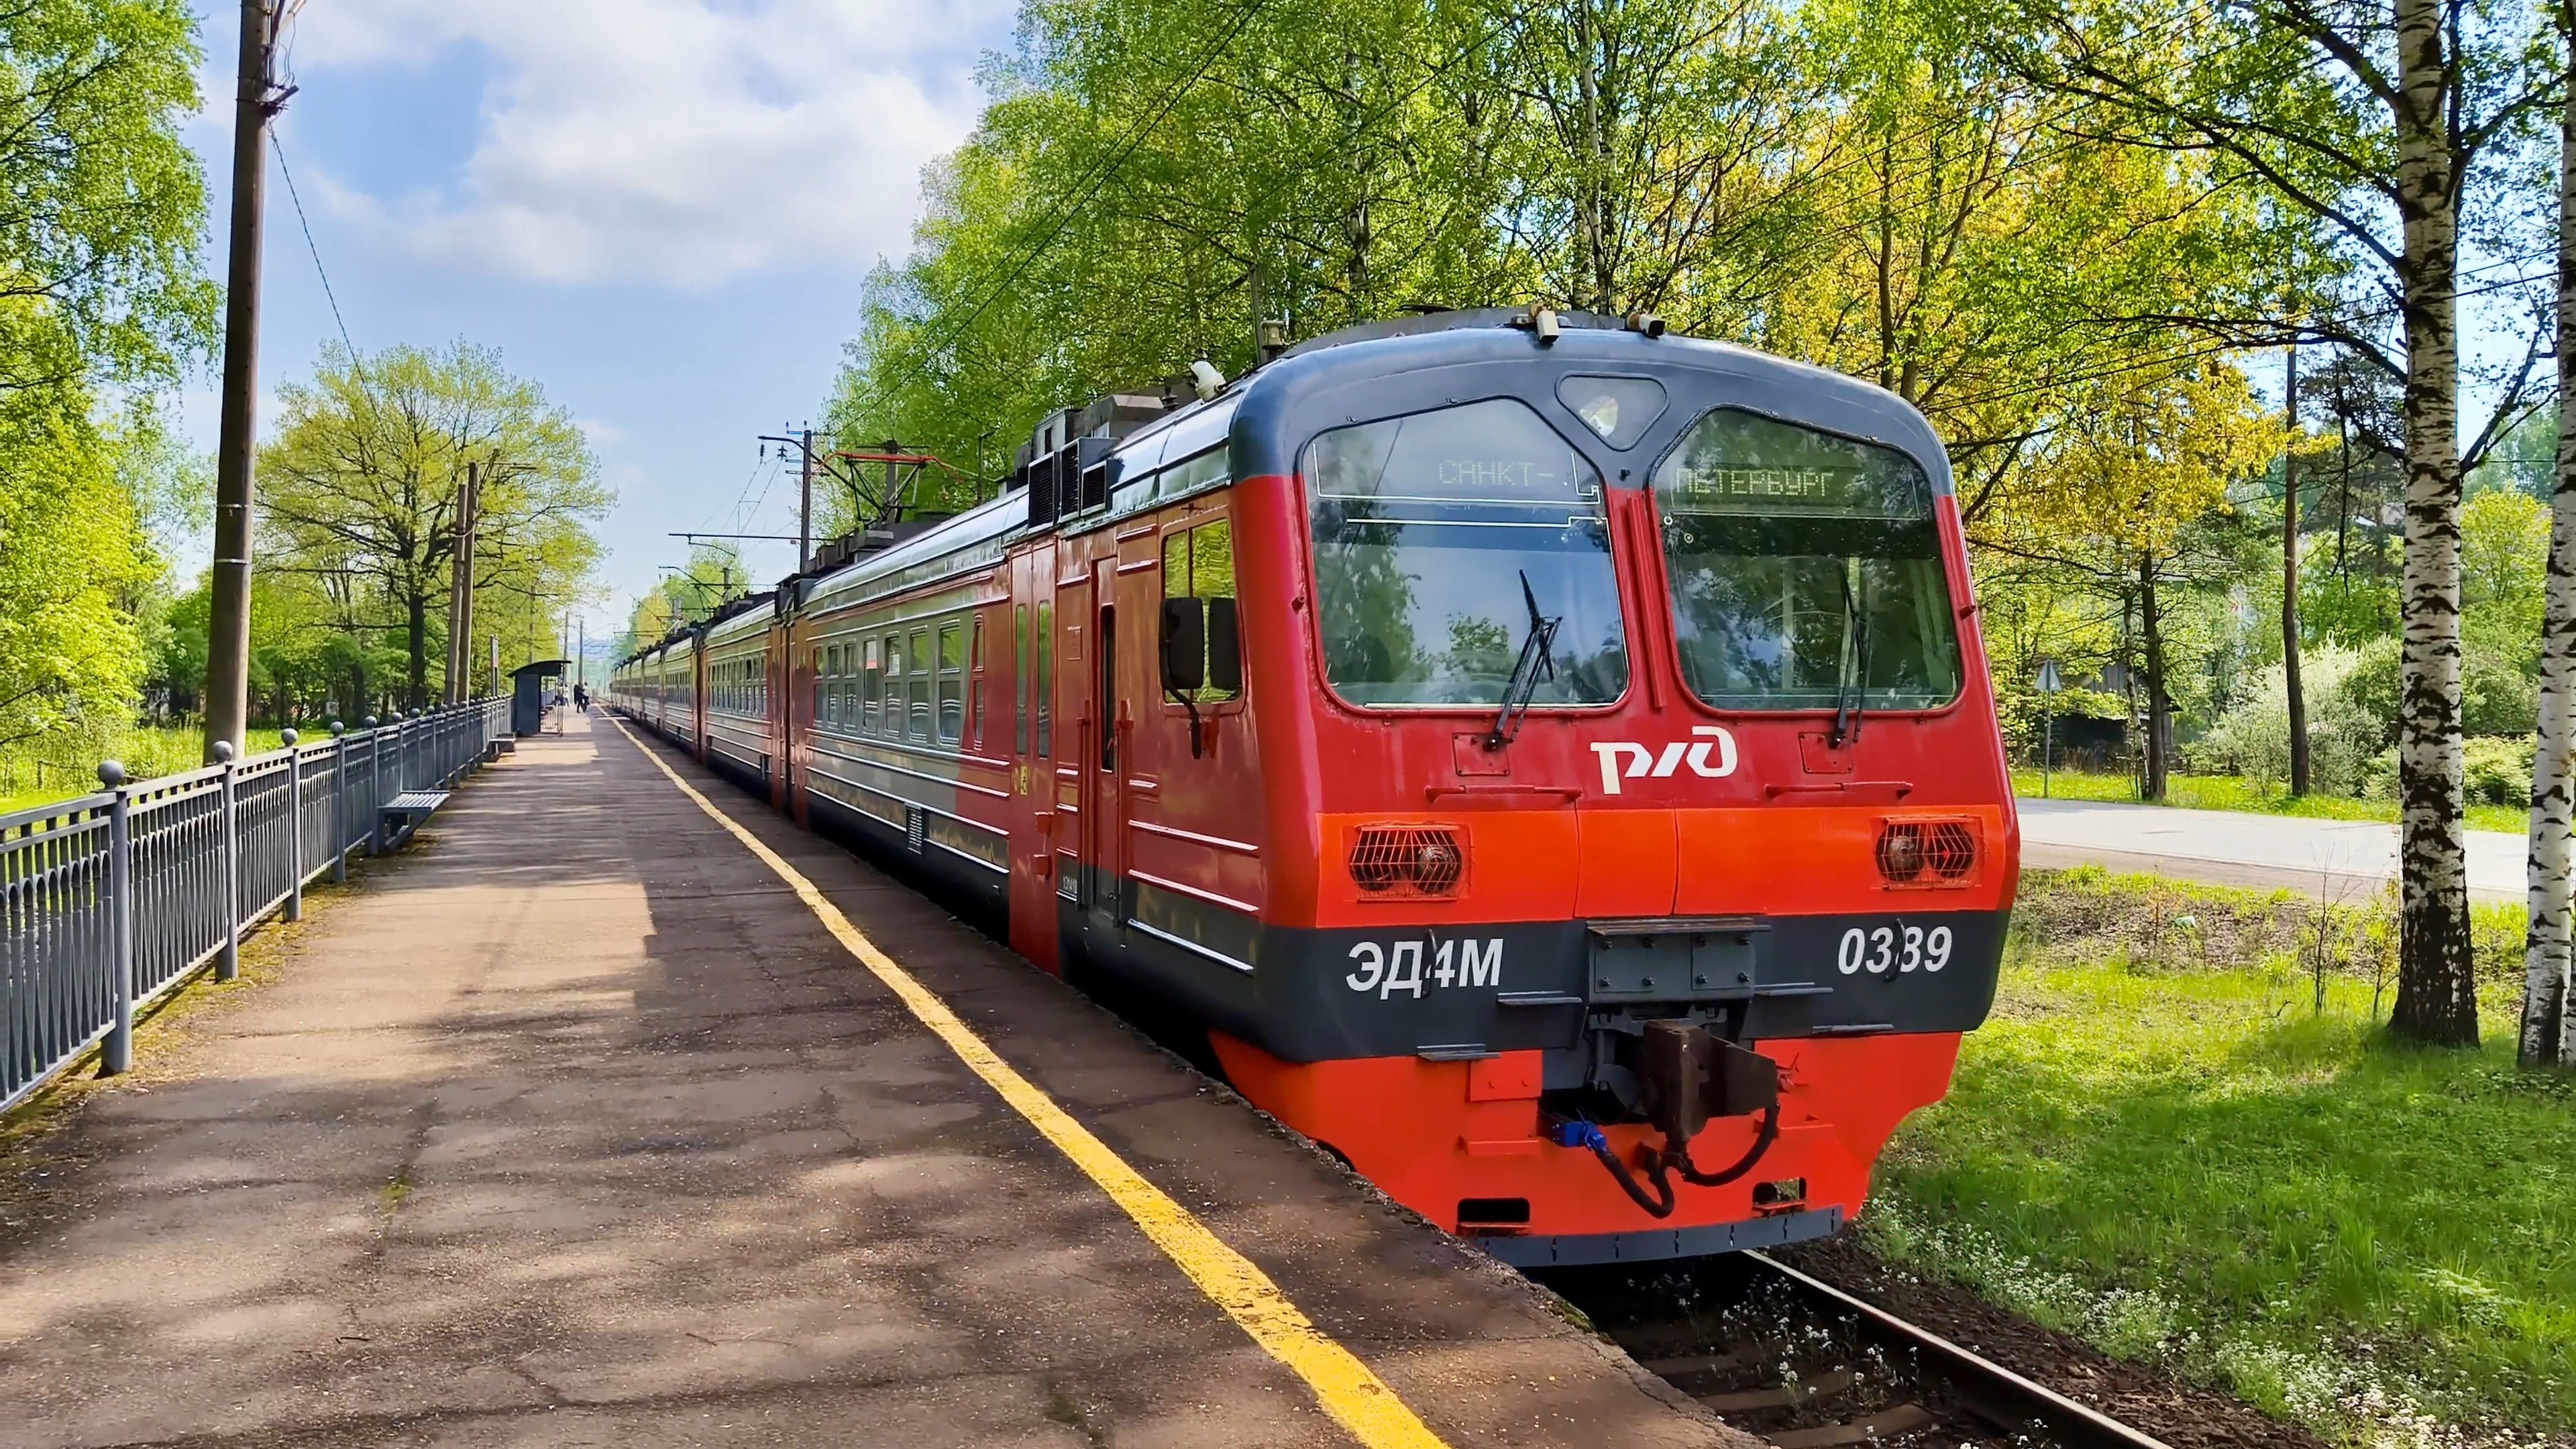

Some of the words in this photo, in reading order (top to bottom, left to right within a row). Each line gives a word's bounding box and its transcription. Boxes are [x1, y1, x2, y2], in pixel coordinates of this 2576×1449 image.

[1439, 460, 1555, 487] САНКТ-
[1676, 468, 1834, 496] ПЕТЕРБУРГ
[1590, 725, 1738, 795] РЖД
[1346, 938, 1503, 1000] ЭД4М
[1838, 926, 1952, 975] 0389
